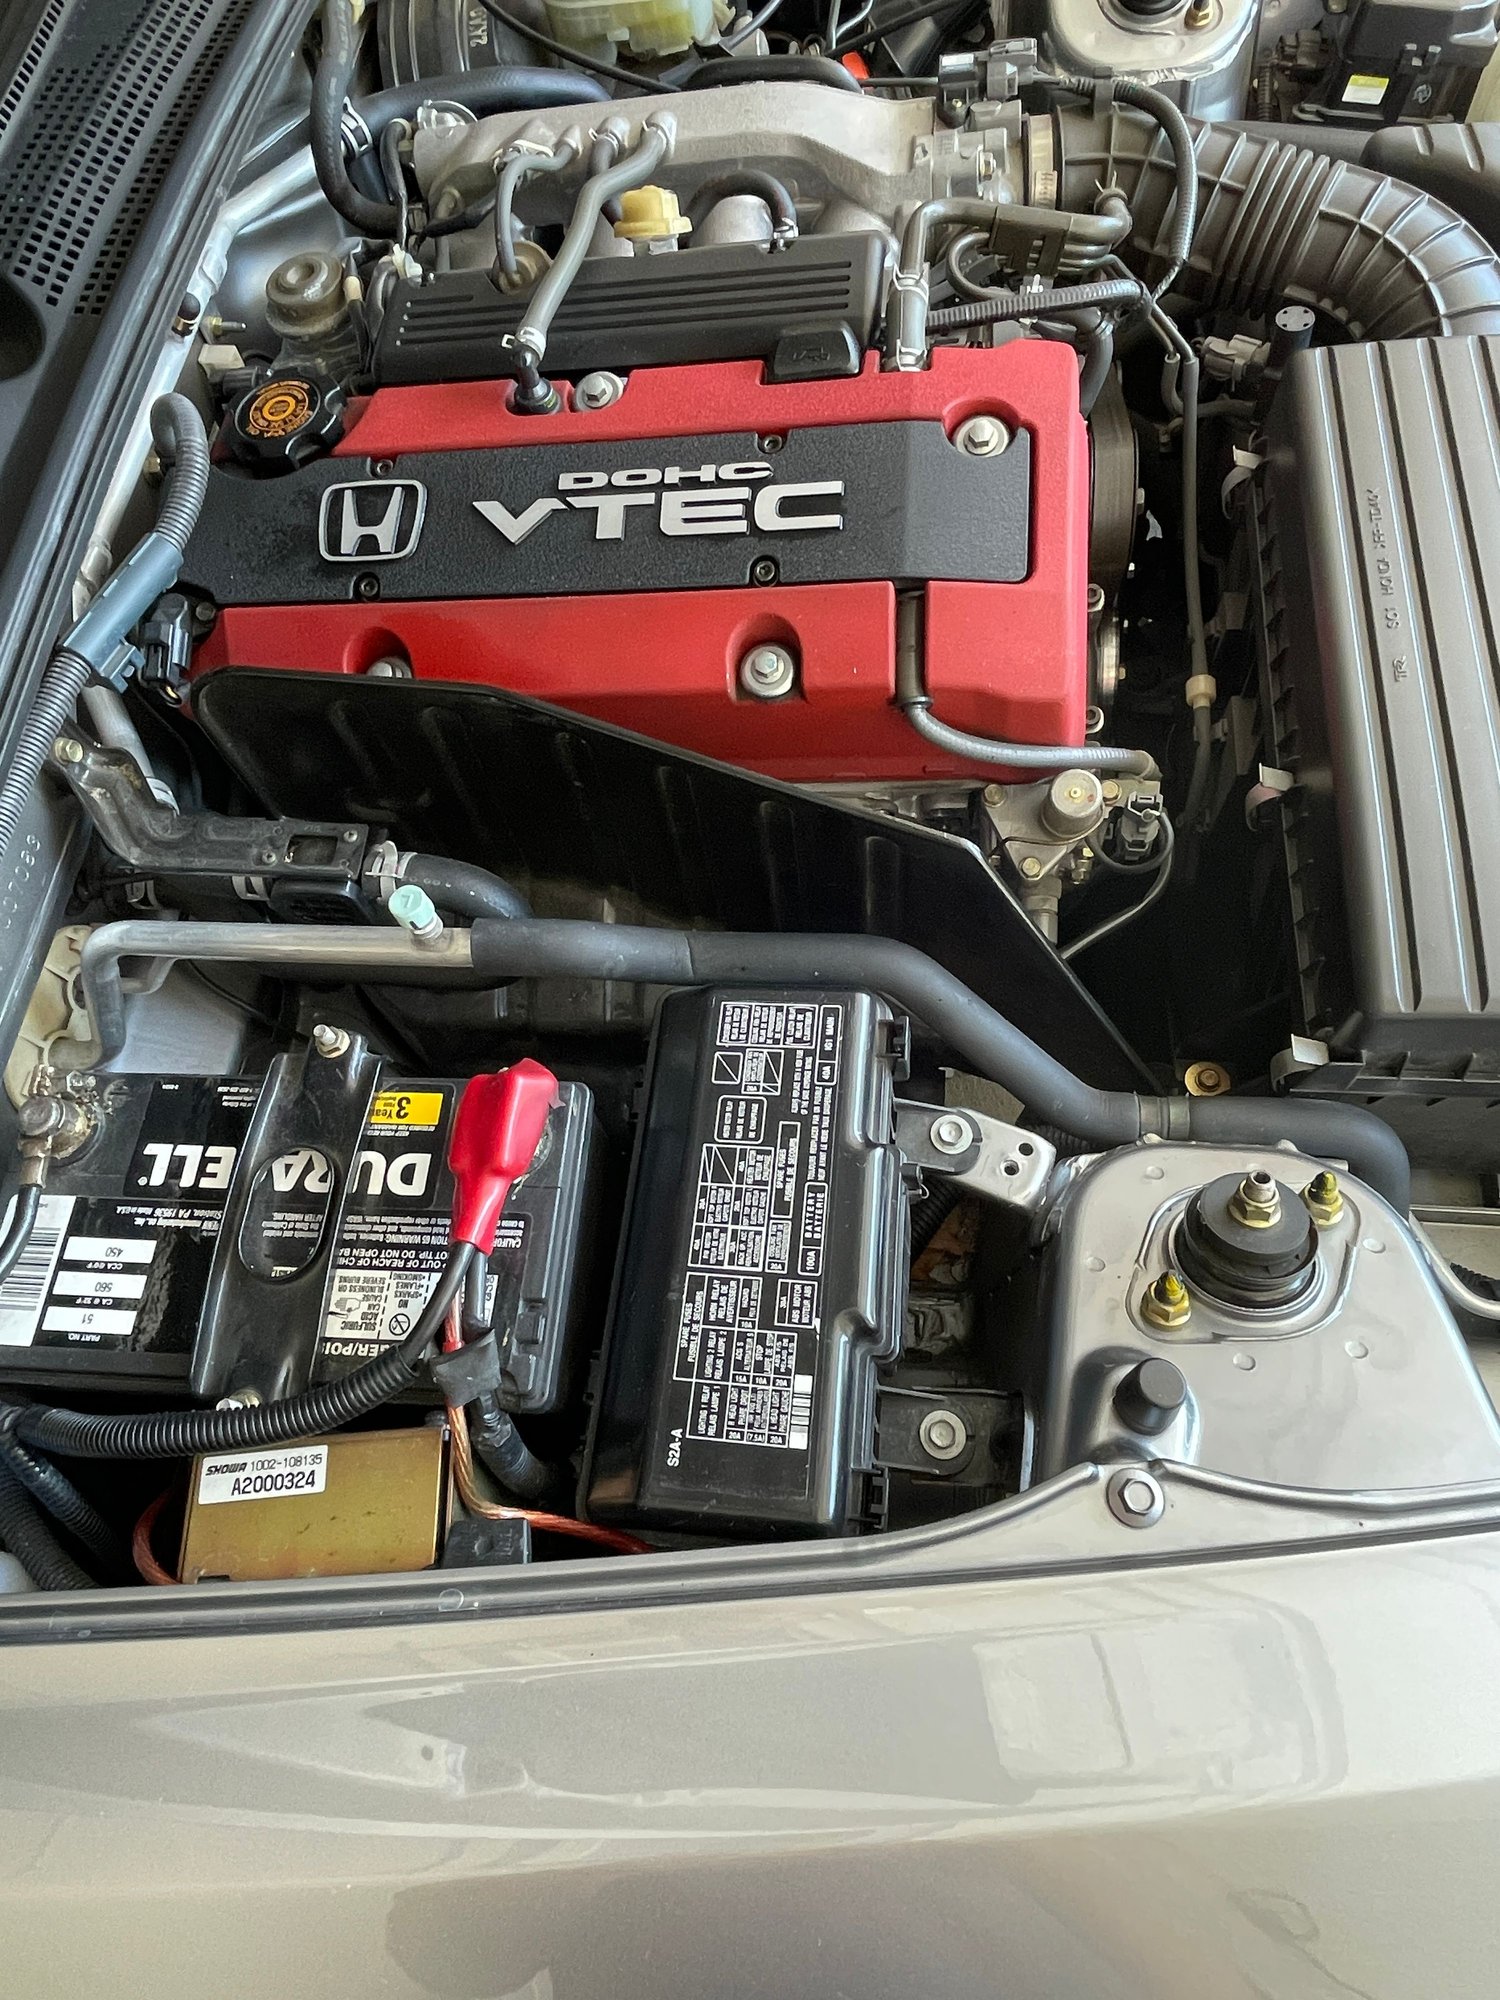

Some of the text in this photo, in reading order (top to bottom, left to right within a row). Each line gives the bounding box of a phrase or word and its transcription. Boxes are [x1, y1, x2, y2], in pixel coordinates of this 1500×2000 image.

[558, 461, 773, 489] DOHC
[473, 481, 844, 545] VTEC
[824, 1016, 834, 1050] IG1 MAIN
[821, 1065, 830, 1079] 40A
[395, 1096, 410, 1119] 3
[821, 1115, 829, 1128] TAUX
[806, 1085, 822, 1180] TOUJOURS REMPLACER PAR UN FUSIBLE
[818, 1151, 826, 1167] AYANT
[775, 1148, 786, 1188] SPARE FUSES
[783, 1137, 797, 1201] FUSIBLE DE SECOURS
[153, 1207, 176, 1217] 19536
[177, 1208, 191, 1218] PA
[804, 1191, 815, 1238] BATTERY
[813, 1192, 824, 1238] BATTERIE
[156, 1216, 202, 1228] manufacturing
[384, 1233, 420, 1243] WARNING:
[104, 1246, 123, 1257] 450
[351, 1248, 378, 1257] OPEN
[379, 1248, 399, 1258] NOT
[401, 1249, 415, 1258] DO
[805, 1250, 815, 1270] 100A
[356, 1257, 441, 1269] OUT OF REACH OF
[94, 1281, 112, 1292] 560
[337, 1284, 384, 1293] BLINDNESS OR
[361, 1276, 386, 1285] SEVERE
[361, 1293, 381, 1302] CAUSE
[397, 1298, 408, 1308] NO
[708, 1279, 719, 1320] HORN RELAY
[717, 1284, 728, 1318] RELAIS DE
[725, 1280, 737, 1323] AVERTISSEUR
[741, 1287, 749, 1307] HAZARD
[791, 1283, 801, 1323] ABS MOTOR
[801, 1285, 812, 1322] MOTEUR ABS
[366, 1303, 380, 1311] CAN
[81, 1313, 93, 1324] 51
[360, 1311, 378, 1321] ACID
[680, 1302, 693, 1347] SPARE FUSES
[339, 1320, 376, 1331] SULFURIC
[687, 1290, 703, 1362] FUSIBLE DE SECOURS
[67, 1332, 80, 1340] NO.
[707, 1330, 716, 1347] RELAY
[716, 1336, 726, 1356] LAMPE
[743, 1337, 753, 1370] ALTERNATEUR
[755, 1344, 763, 1360] STOP
[763, 1332, 774, 1374] LAMPE DE STOP
[704, 1354, 714, 1377] LIGHTING
[713, 1358, 723, 1379] RELAIS
[779, 1349, 787, 1372] RELAIS
[735, 1374, 747, 1382] 15A
[755, 1376, 767, 1384] 10A
[775, 1378, 787, 1386] 20A
[700, 1384, 710, 1402] RELAY
[710, 1391, 720, 1412] LAMPE
[730, 1387, 738, 1402] LIGHT
[771, 1391, 779, 1407] LIGHT
[728, 1404, 736, 1419] HEAD
[737, 1389, 748, 1425] PHARE DROIT
[770, 1408, 778, 1423] HEAD
[778, 1390, 789, 1432] PHARE GAUCHE
[697, 1409, 707, 1433] LIGHTING
[707, 1414, 717, 1436] RELAIS
[728, 1431, 740, 1439] 20A
[769, 1435, 782, 1443] 20A
[666, 1428, 682, 1466] S2A-A
[205, 1453, 323, 1476] SHOWA 1002-108135
[231, 1469, 316, 1496] A2000324
